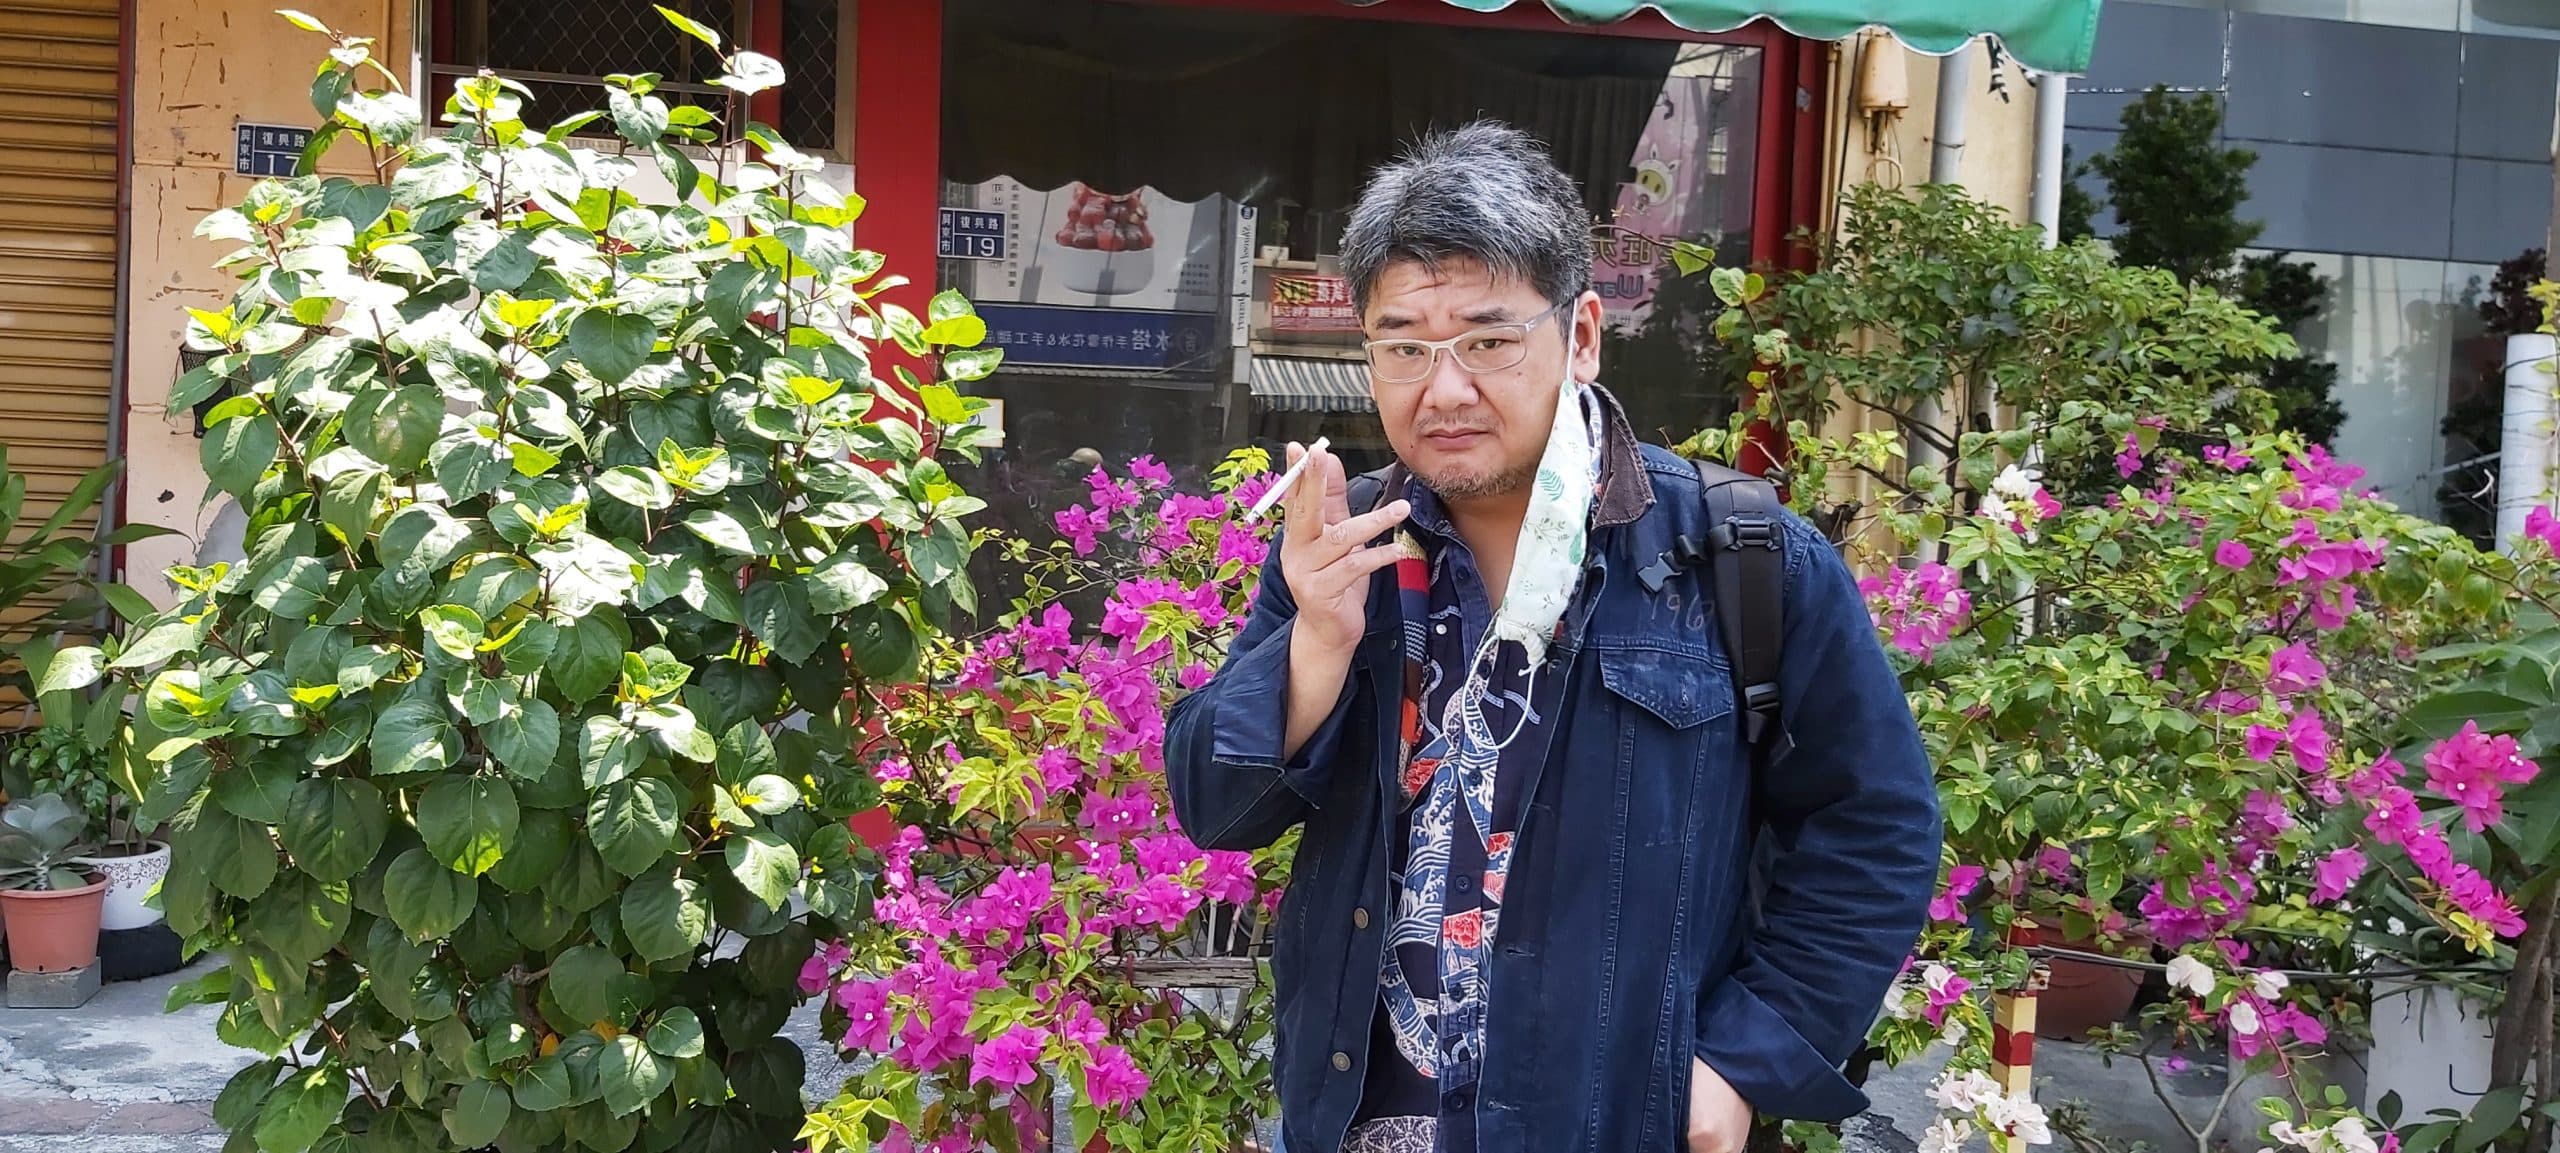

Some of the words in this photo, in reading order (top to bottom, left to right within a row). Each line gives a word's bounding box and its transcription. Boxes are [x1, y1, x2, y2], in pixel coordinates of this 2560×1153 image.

[262, 131, 306, 148] 復興路
[267, 154, 300, 177] 17
[965, 236, 996, 257] 19
